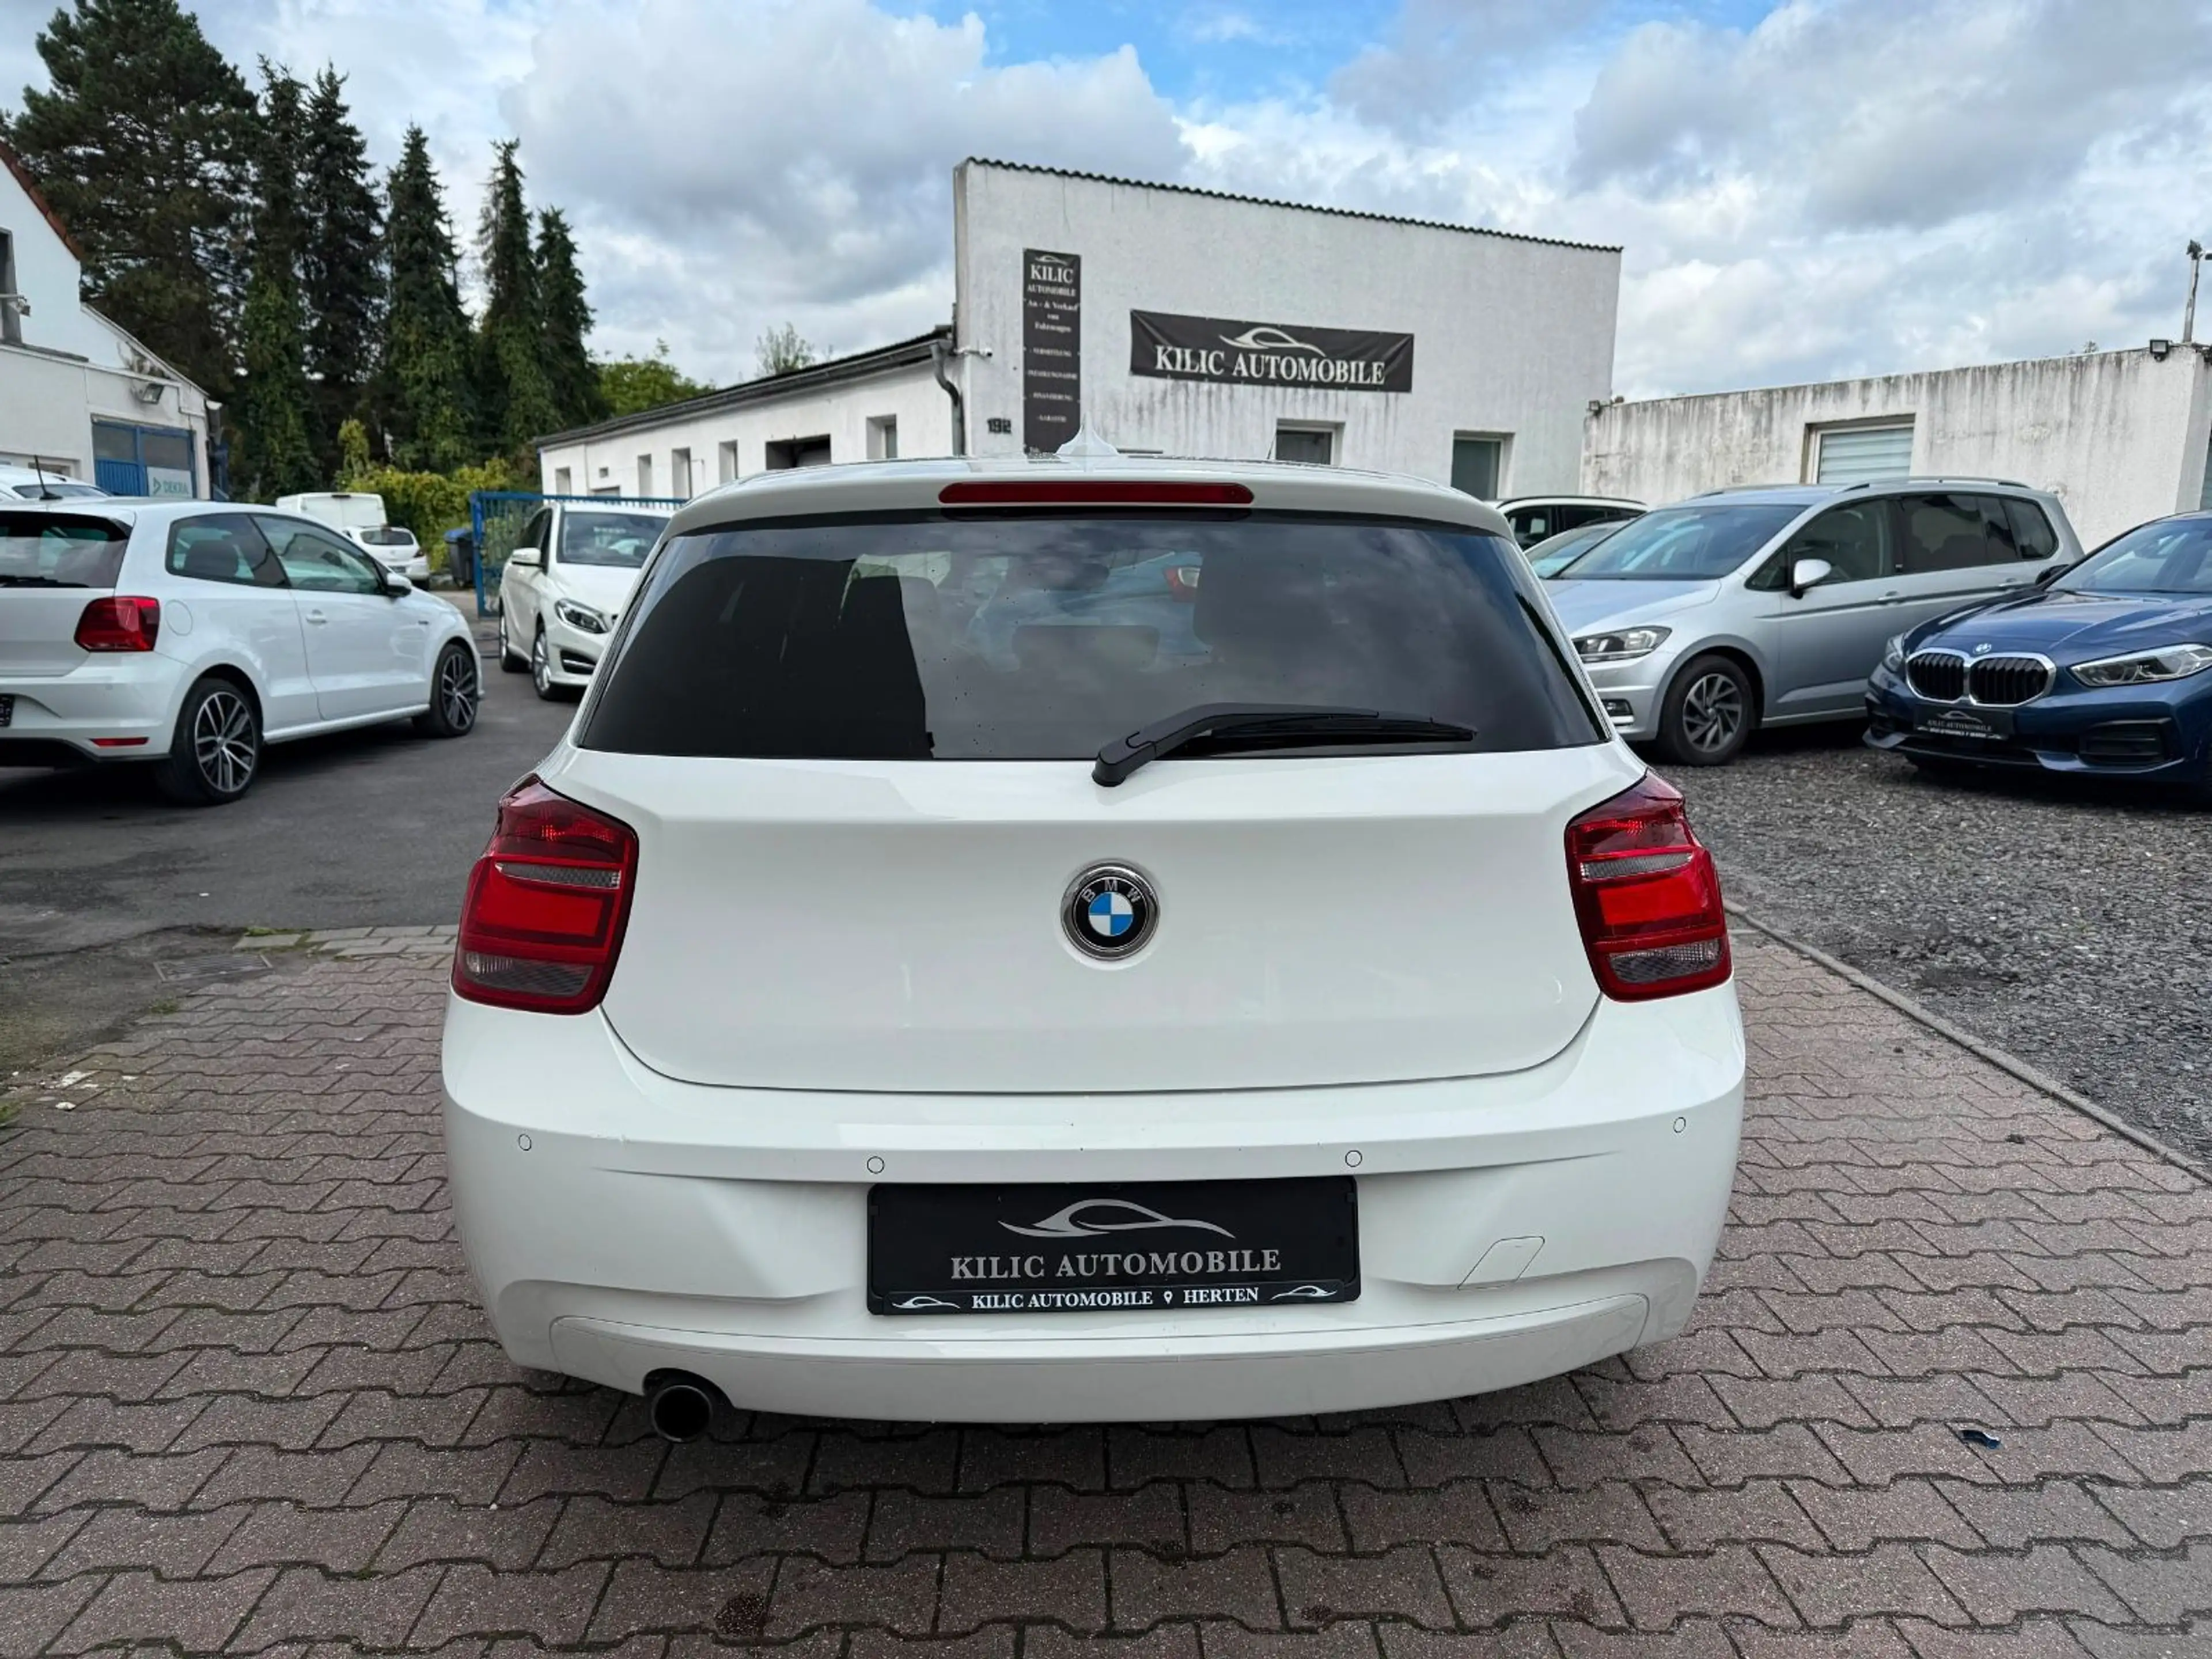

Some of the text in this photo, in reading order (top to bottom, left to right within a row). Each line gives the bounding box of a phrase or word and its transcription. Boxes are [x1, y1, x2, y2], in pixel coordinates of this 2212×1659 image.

[1030, 264, 1074, 283] KILIC
[1154, 344, 1385, 385] KILIC AUTOMOBILE
[1081, 878, 1141, 903] BMW
[951, 1249, 1281, 1279] KILIC AUTOMOBILE
[971, 1287, 1259, 1309] KILIC AUTOMOBILE HERTEN
